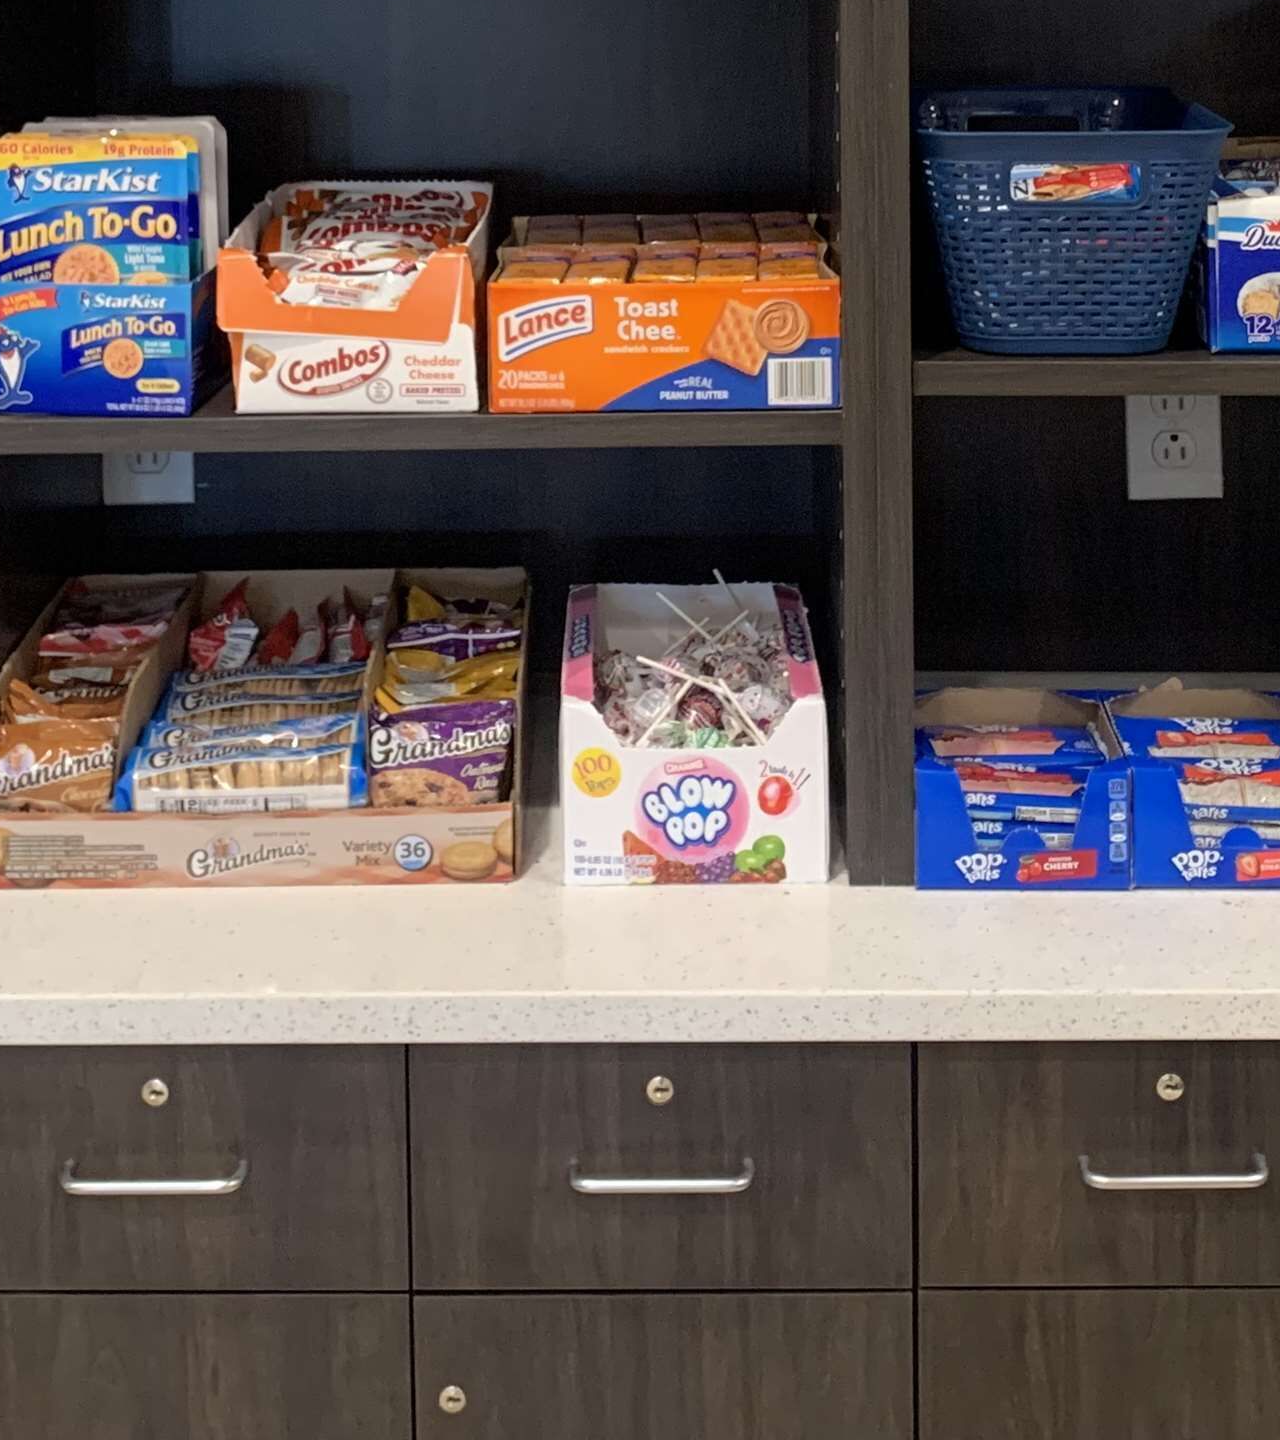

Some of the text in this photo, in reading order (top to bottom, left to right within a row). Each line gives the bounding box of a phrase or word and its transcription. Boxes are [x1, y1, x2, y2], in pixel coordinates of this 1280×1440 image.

[22, 142, 74, 156] Calories
[102, 143, 176, 158] 19g Protein
[32, 167, 161, 194] StarKist
[93, 293, 167, 309] StarKist
[614, 296, 679, 319] Toast
[70, 321, 122, 348] Lunch
[503, 304, 586, 346] Lance
[617, 320, 676, 341] Chee
[1244, 316, 1272, 335] 12
[288, 344, 381, 385] Combos
[404, 355, 462, 367] Cheddar
[409, 369, 455, 381] Cheese
[498, 370, 518, 390] 20
[688, 377, 713, 389] REAL
[659, 390, 729, 400] PEANUT BUTTER
[369, 722, 512, 768] Grandma's
[572, 753, 612, 777] 100
[643, 775, 735, 823] BLOW
[665, 811, 730, 847] POP
[342, 840, 391, 857] Variety
[399, 841, 426, 859] 36
[186, 839, 308, 879] Grandma's
[355, 852, 381, 866] Mix
[954, 853, 1004, 874] Pop
[1042, 861, 1080, 872] CHERRY
[1172, 850, 1222, 872] Pop
[967, 866, 1001, 884] tarts
[1183, 865, 1218, 881] tarts
